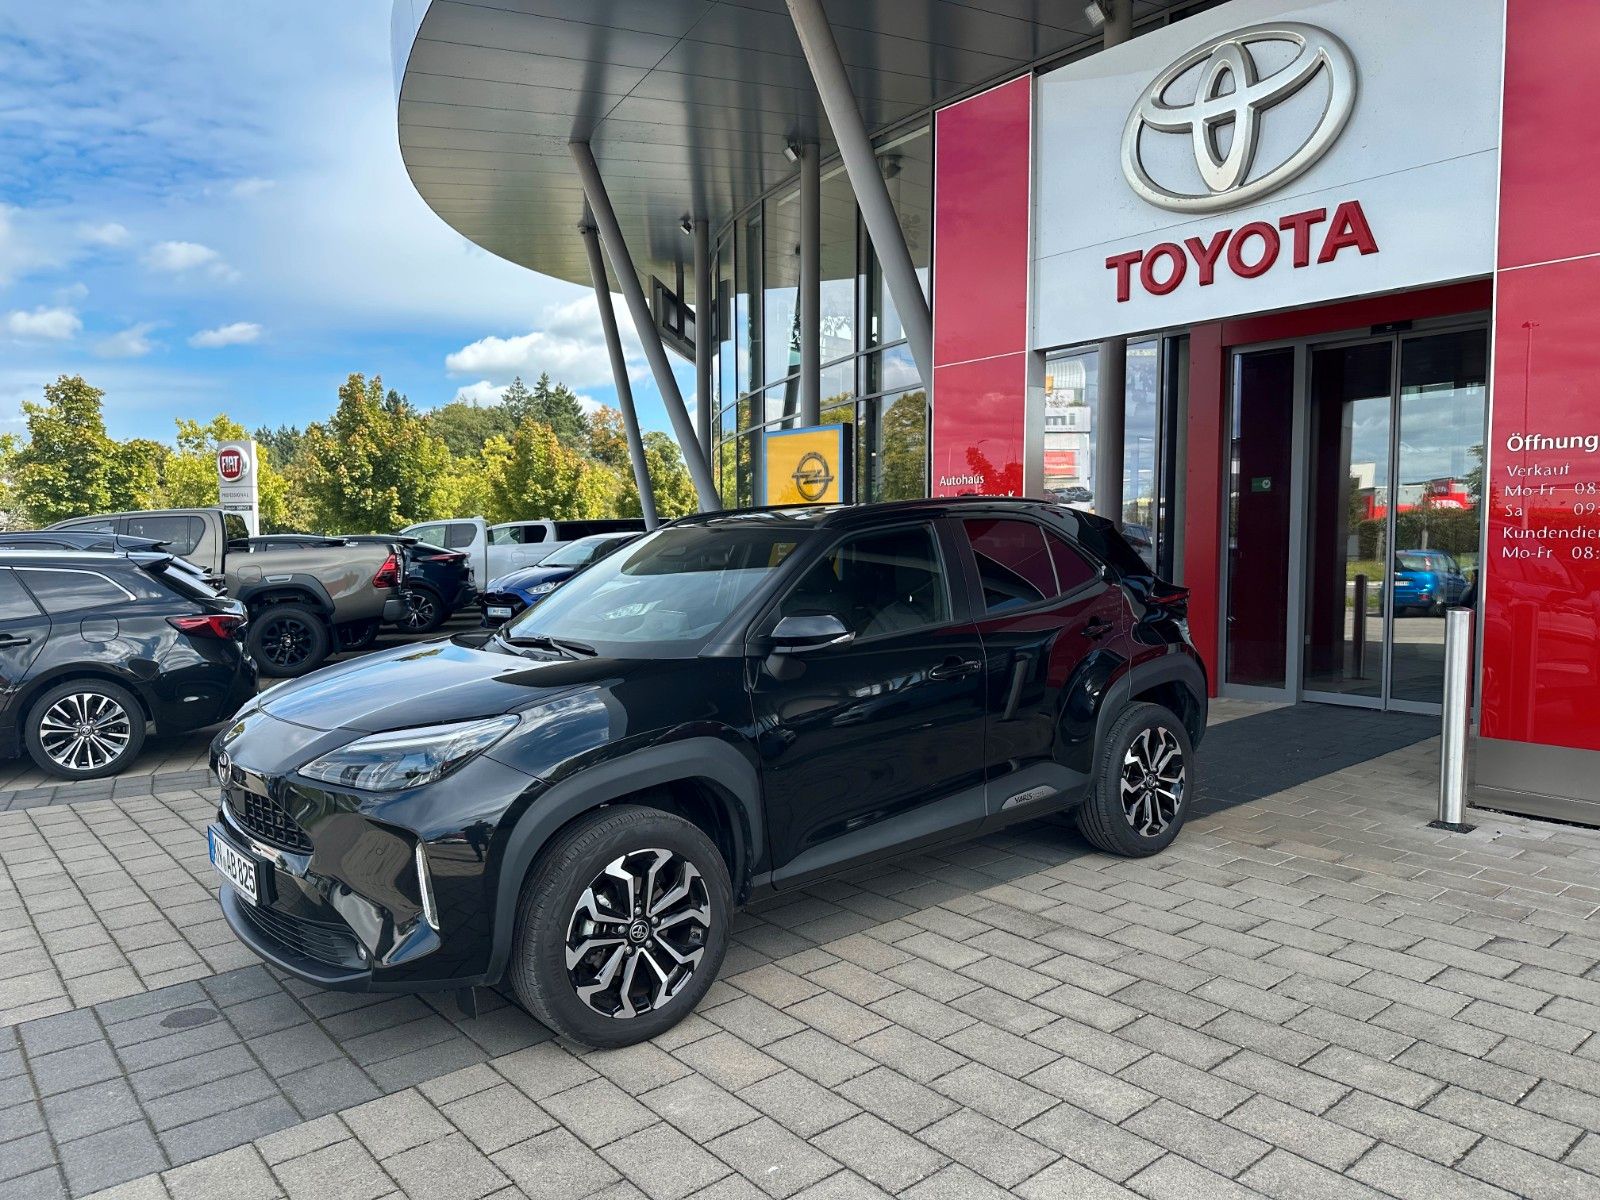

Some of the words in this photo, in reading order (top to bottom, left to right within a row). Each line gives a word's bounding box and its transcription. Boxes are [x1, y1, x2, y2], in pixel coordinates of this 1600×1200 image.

[1105, 199, 1379, 303] TOYOTA
[1506, 432, 1599, 453] Öffnung
[221, 455, 239, 473] FIAT
[1506, 463, 1570, 477] Verkauf
[939, 474, 985, 486] Autohaus
[1504, 483, 1556, 497] Mo-Fr
[1504, 503, 1523, 517] Sa
[1502, 546, 1553, 559] Mo-Fr
[237, 857, 255, 894] 825
